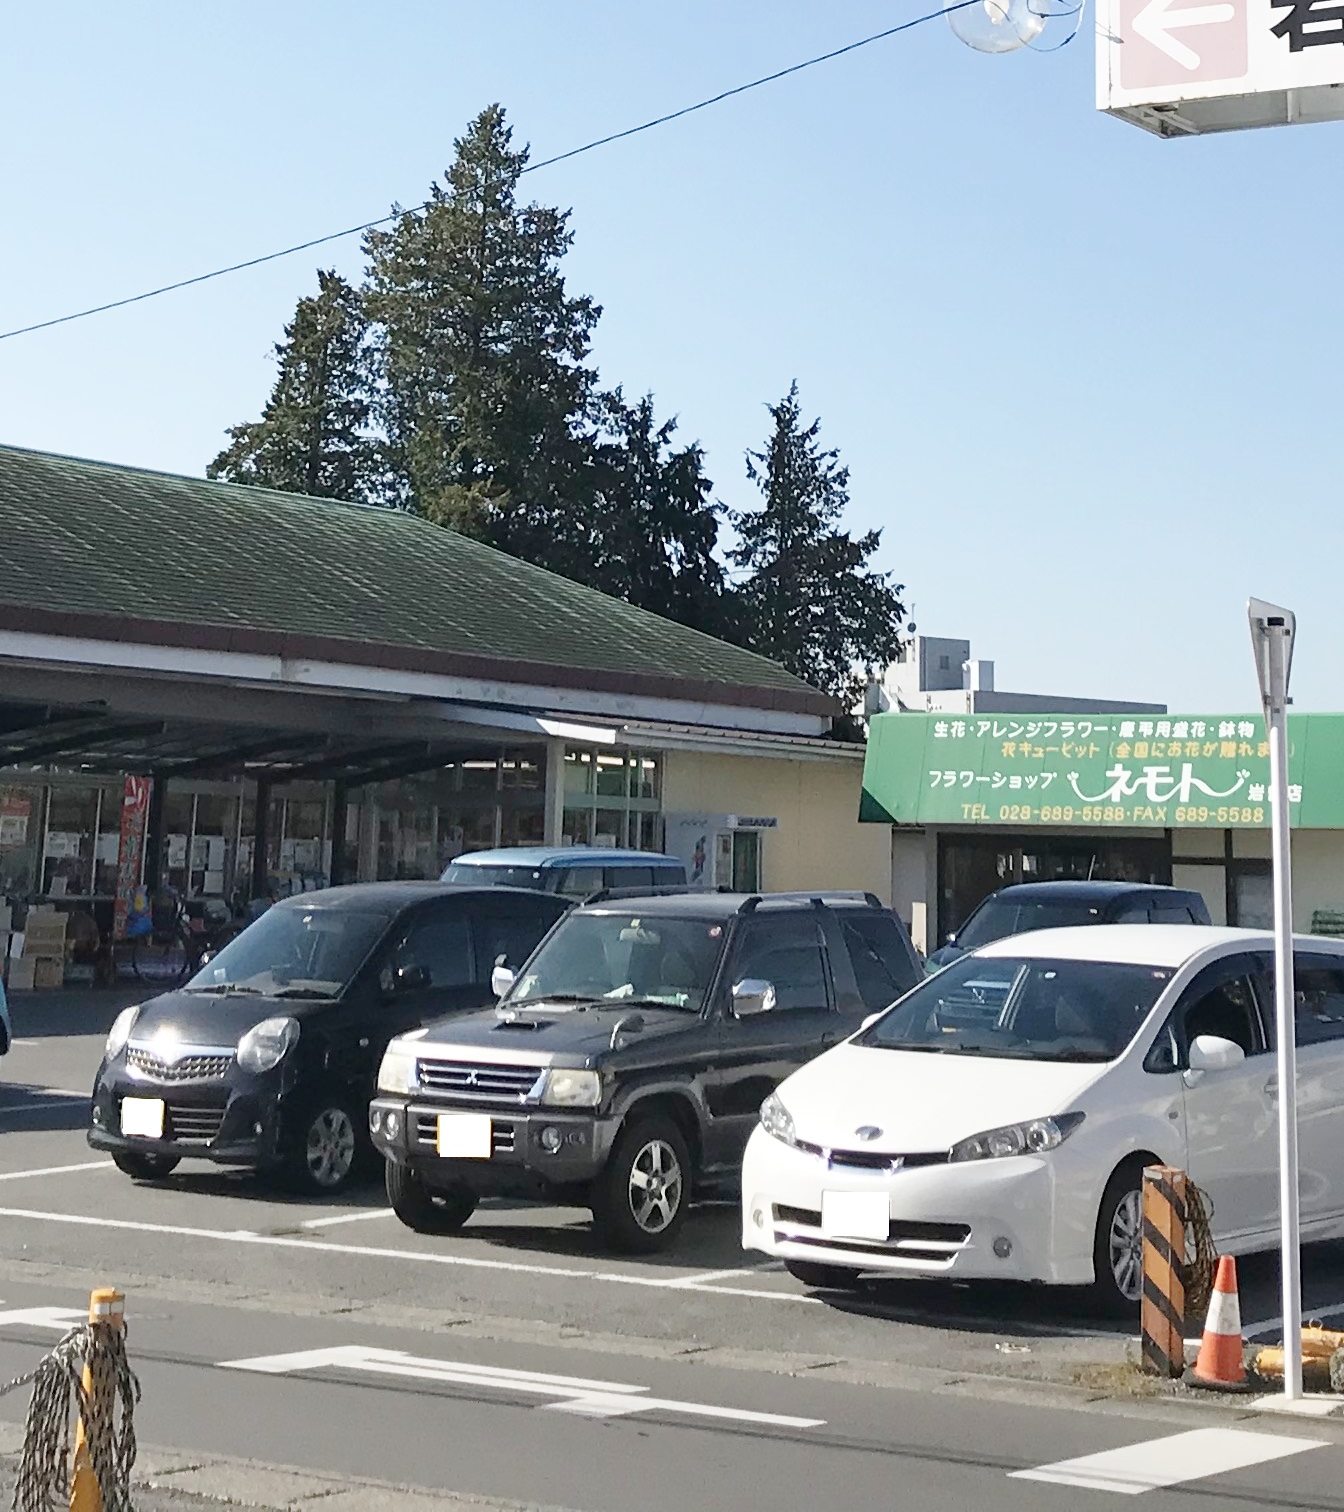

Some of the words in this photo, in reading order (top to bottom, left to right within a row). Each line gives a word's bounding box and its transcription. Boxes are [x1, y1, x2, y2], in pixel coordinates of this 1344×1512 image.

[929, 770, 1058, 790] フラワーショップ
[1247, 783, 1303, 803] 岩店
[960, 803, 991, 820] TEL
[1174, 806, 1264, 823] 689-5588
